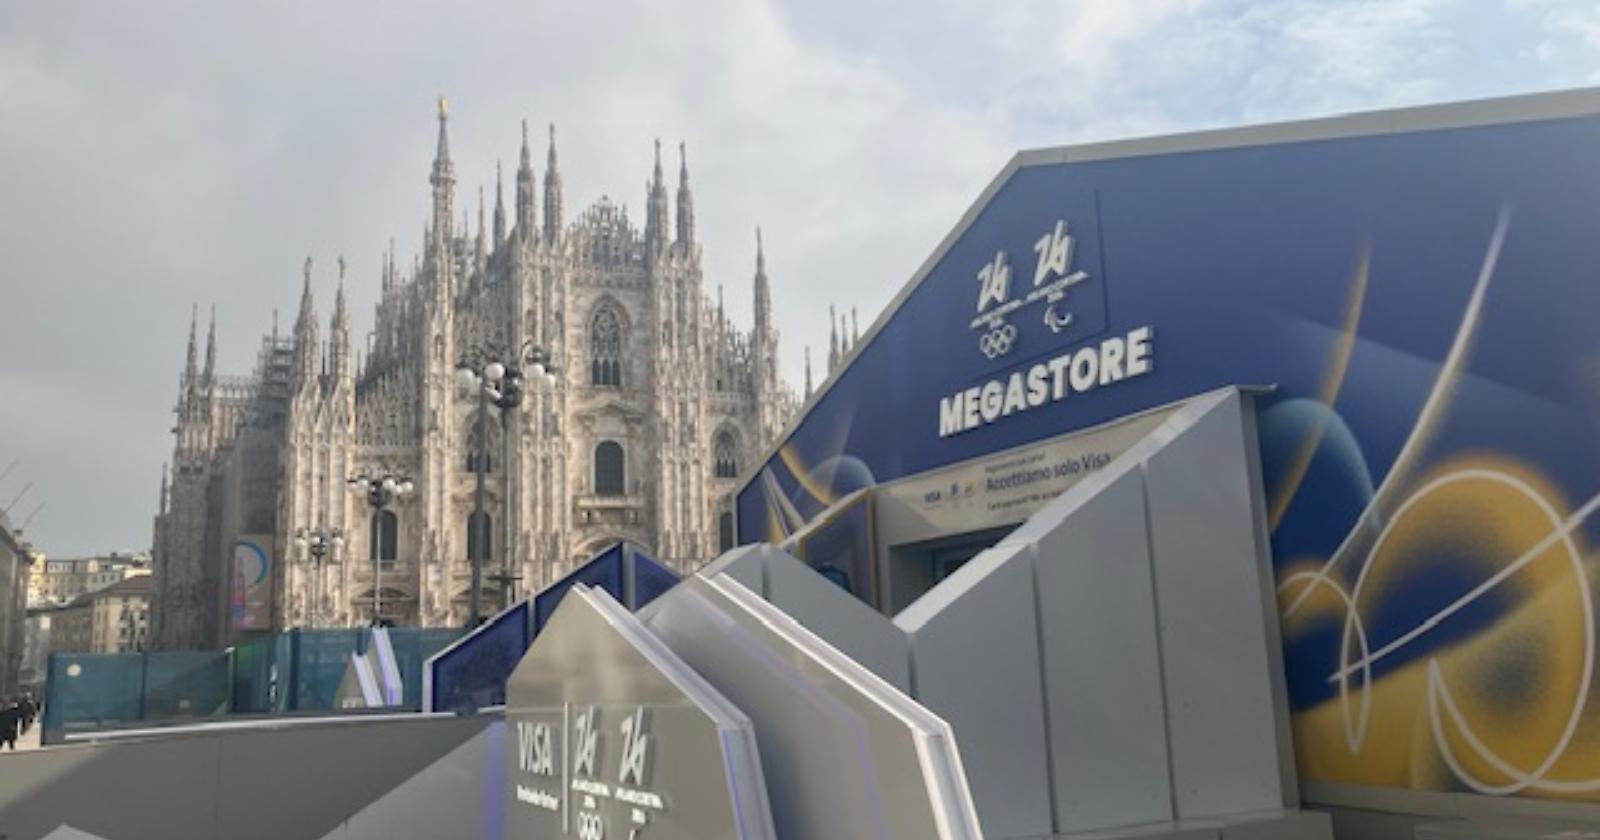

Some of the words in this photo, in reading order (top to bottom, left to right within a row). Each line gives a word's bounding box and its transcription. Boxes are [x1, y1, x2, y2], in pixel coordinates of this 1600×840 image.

[939, 327, 1152, 438] MEGASTORE
[986, 466, 1052, 491] Accettiamo
[1054, 458, 1080, 477] solo
[1082, 451, 1111, 471] Visa
[517, 722, 553, 776] VISA
